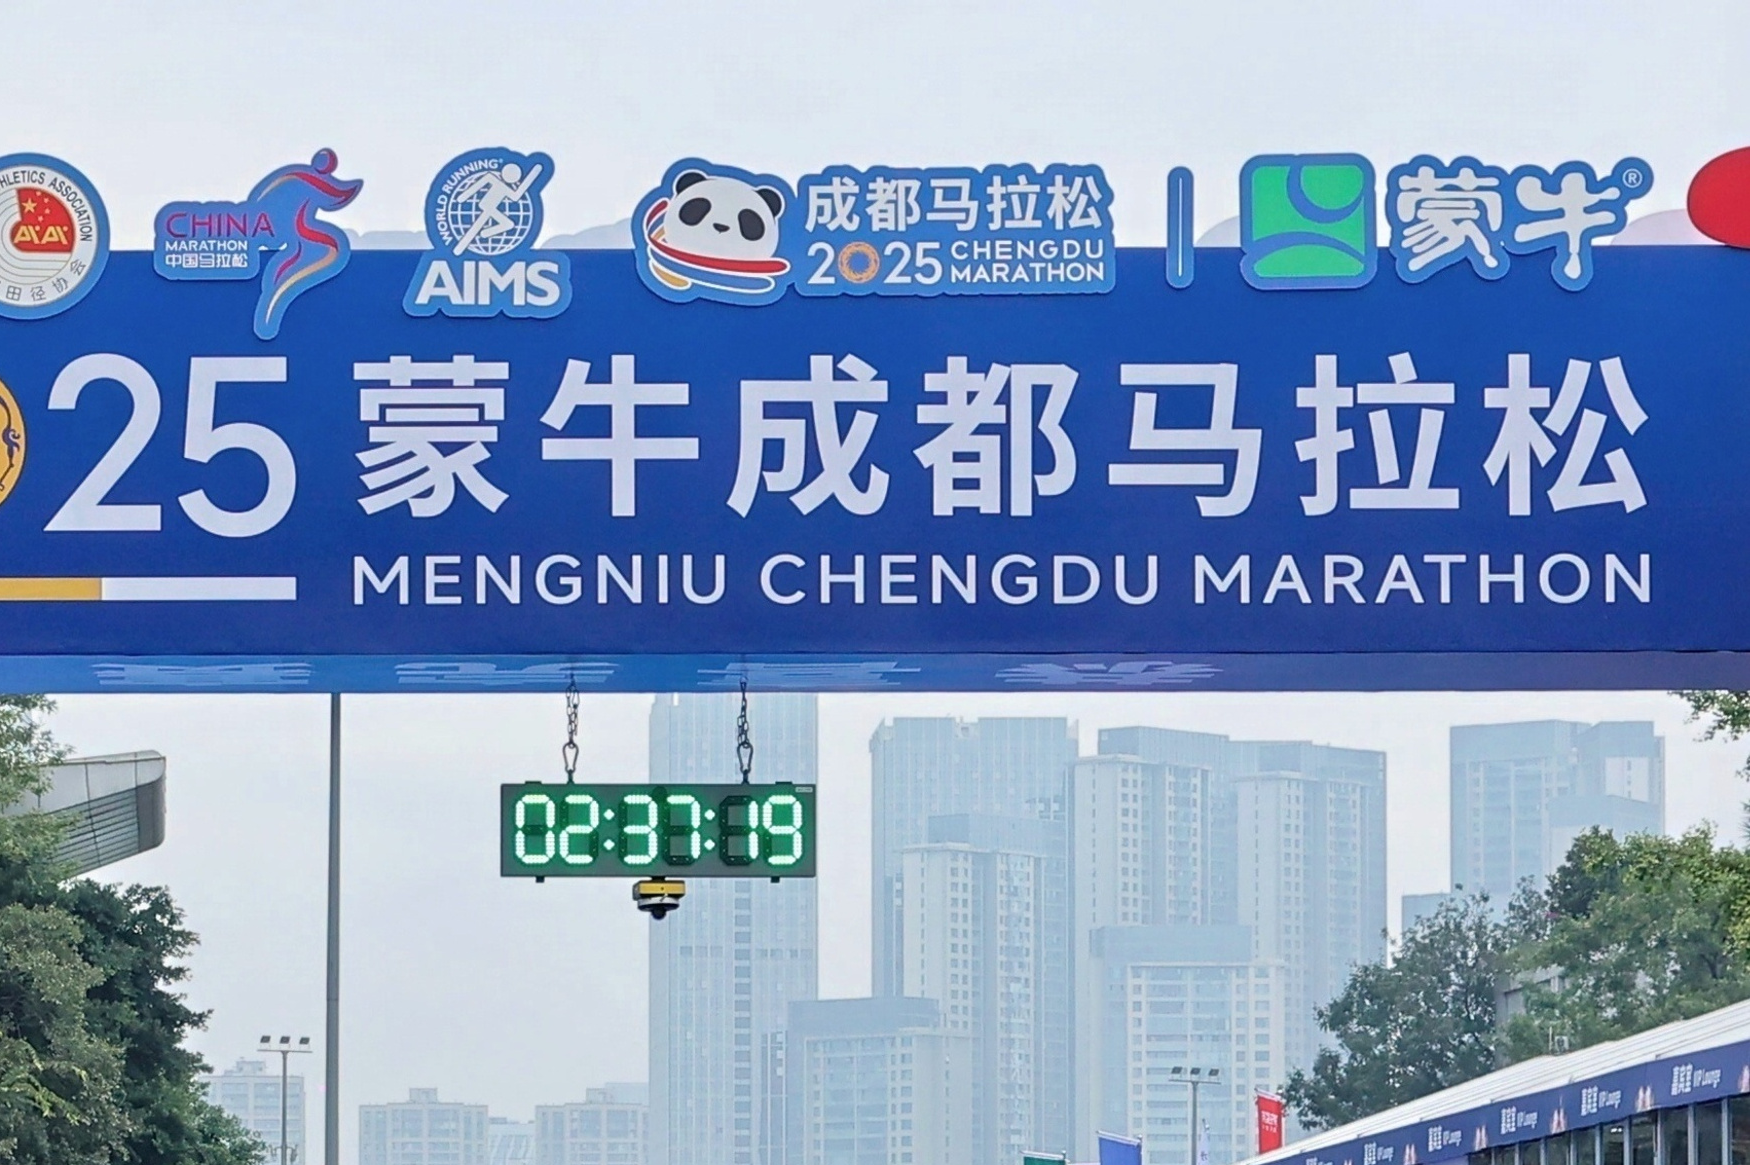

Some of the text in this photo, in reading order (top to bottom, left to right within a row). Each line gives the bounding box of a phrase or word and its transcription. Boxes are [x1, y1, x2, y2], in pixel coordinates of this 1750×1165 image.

[47, 176, 93, 243] ASSOCIATION
[165, 212, 276, 239] CHINA
[436, 158, 499, 246] WORLD RUNNING
[805, 174, 1105, 234] 成都马拉松
[1396, 166, 1622, 279] 蒙牛
[164, 254, 249, 269] 中国马拉松
[165, 240, 249, 252] MARATHON
[950, 240, 1105, 261] CHENGDU
[950, 262, 1105, 284] MARATHON
[414, 260, 561, 306] AIMS
[351, 350, 1651, 519] 蒙牛成都马拉松
[353, 552, 1653, 606] MENGNIU CHENGDU MARATHON
[515, 794, 803, 865] 02:37:19
